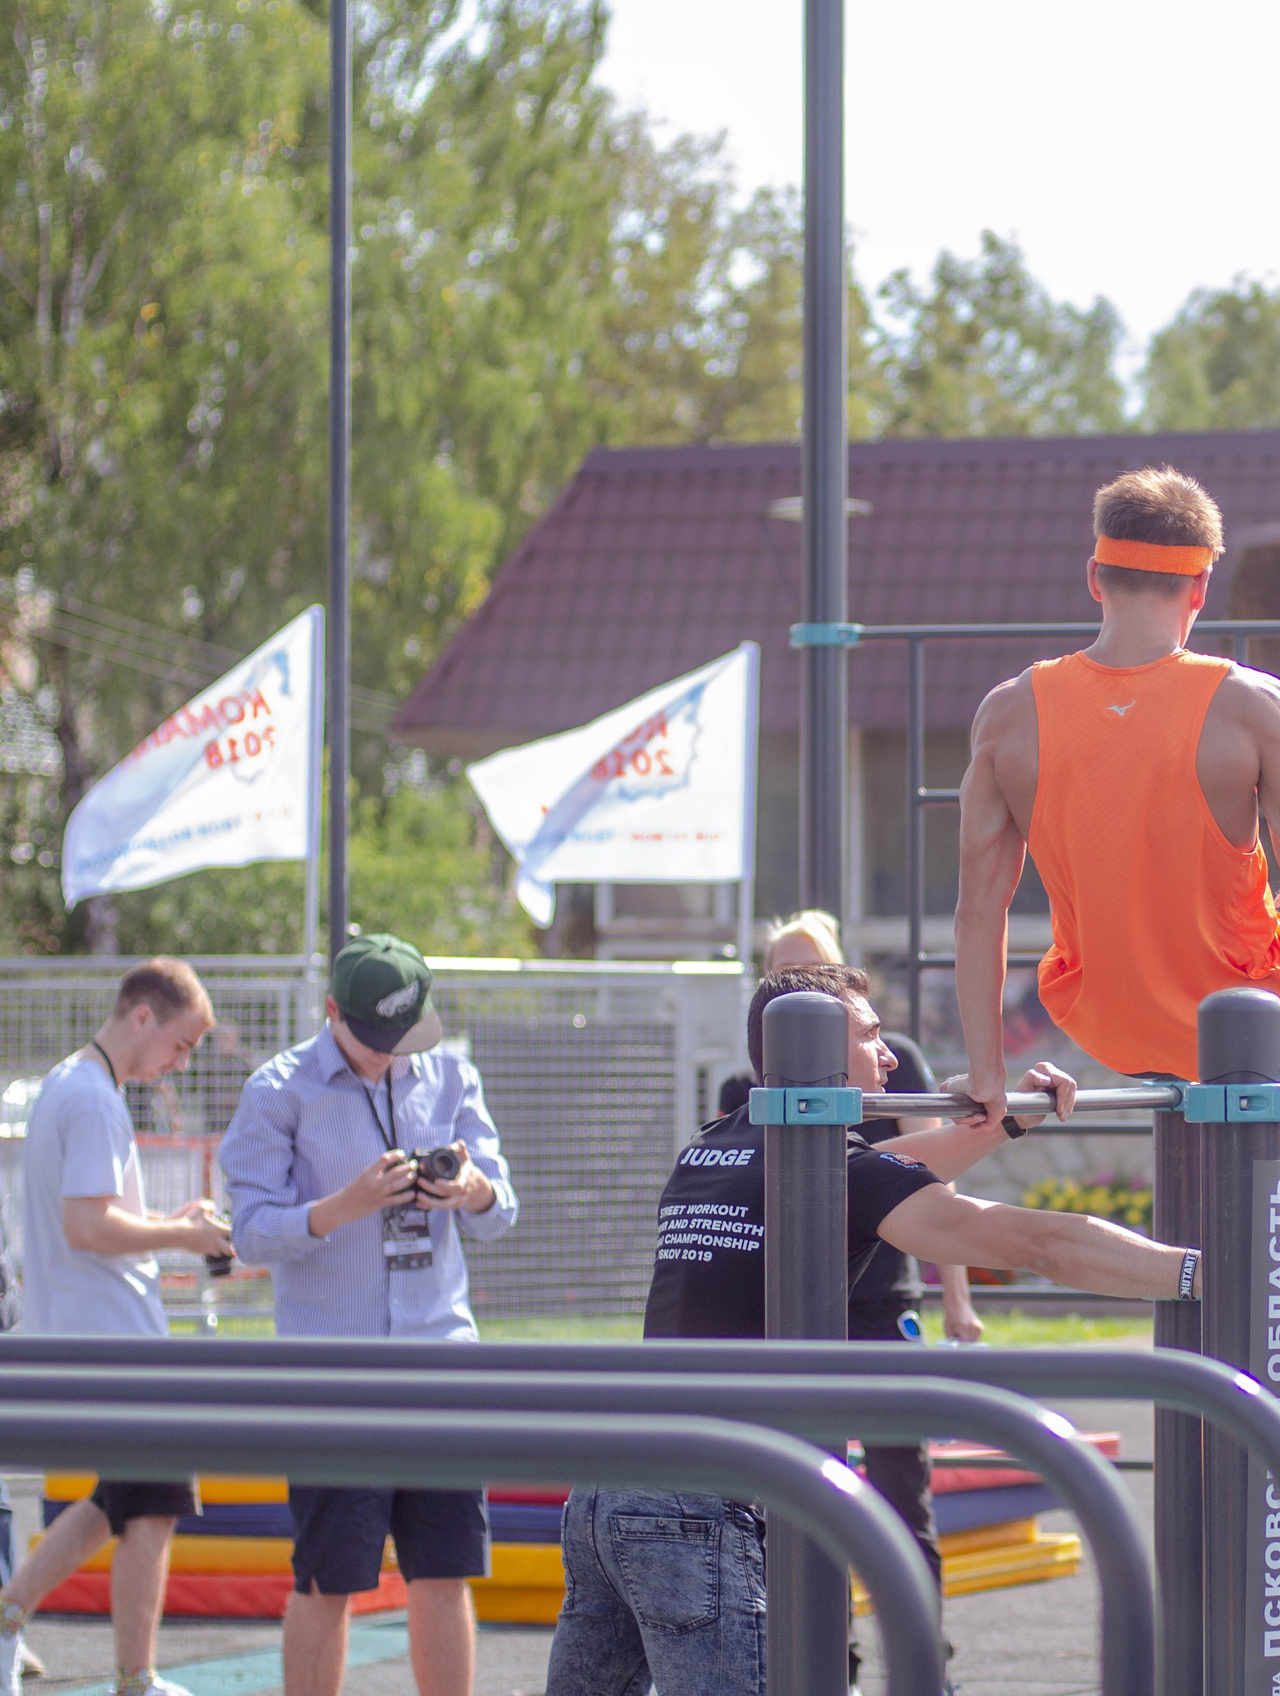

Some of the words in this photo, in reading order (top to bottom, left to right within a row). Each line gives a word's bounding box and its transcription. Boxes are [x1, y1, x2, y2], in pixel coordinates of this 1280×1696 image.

[680, 1148, 756, 1167] JUDGE
[660, 1204, 687, 1219] STREET
[686, 1204, 749, 1218] WORKOUT
[668, 1219, 689, 1230] AND
[689, 1219, 765, 1237] STRENGTH
[664, 1233, 760, 1251] CHAMPIONSHIP
[681, 1250, 713, 1261] 2019
[1181, 1254, 1197, 1295] MUTANT
